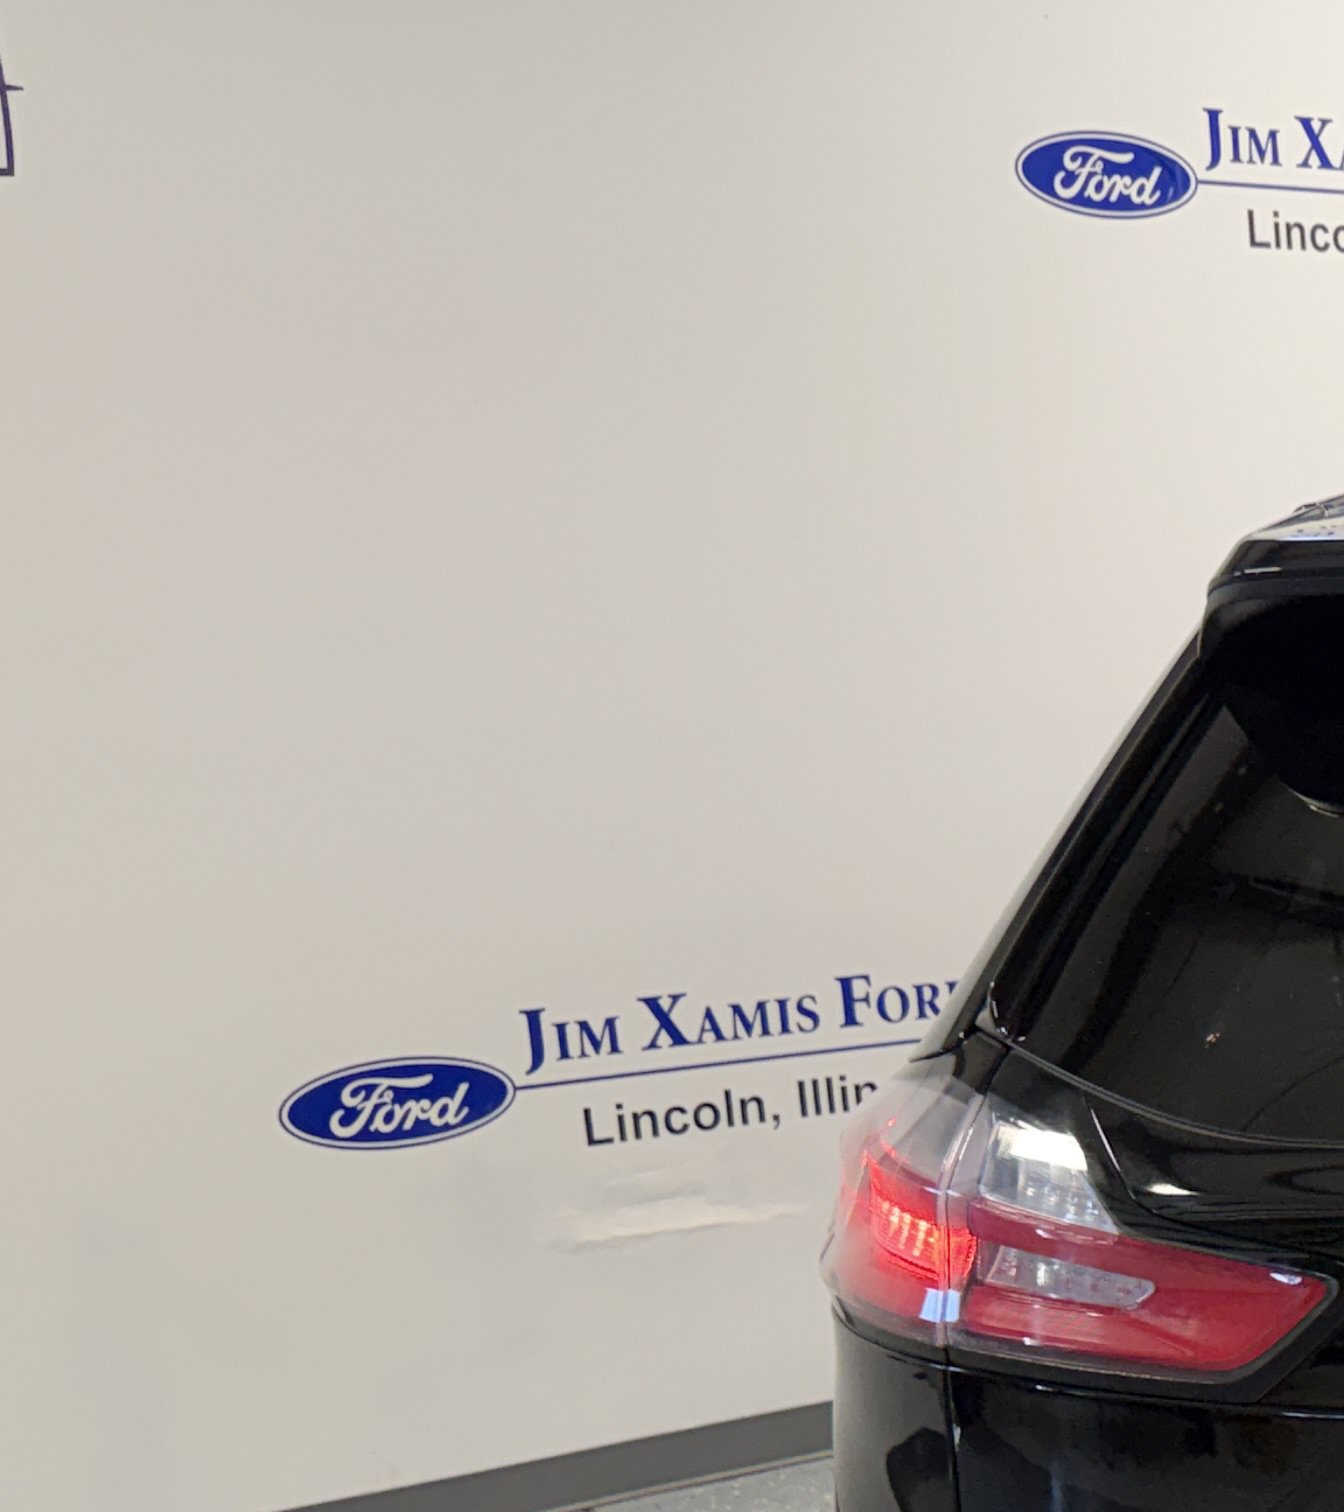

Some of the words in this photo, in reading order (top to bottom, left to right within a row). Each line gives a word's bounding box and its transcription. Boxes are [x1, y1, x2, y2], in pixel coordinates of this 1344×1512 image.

[1201, 107, 1283, 172] JIM
[1053, 144, 1161, 206] Ford
[518, 1007, 624, 1076] JIM
[637, 993, 821, 1053] XAMIS
[835, 974, 958, 1029] FOR
[329, 1073, 469, 1139] Ford
[582, 1088, 782, 1147] Lincoln,
